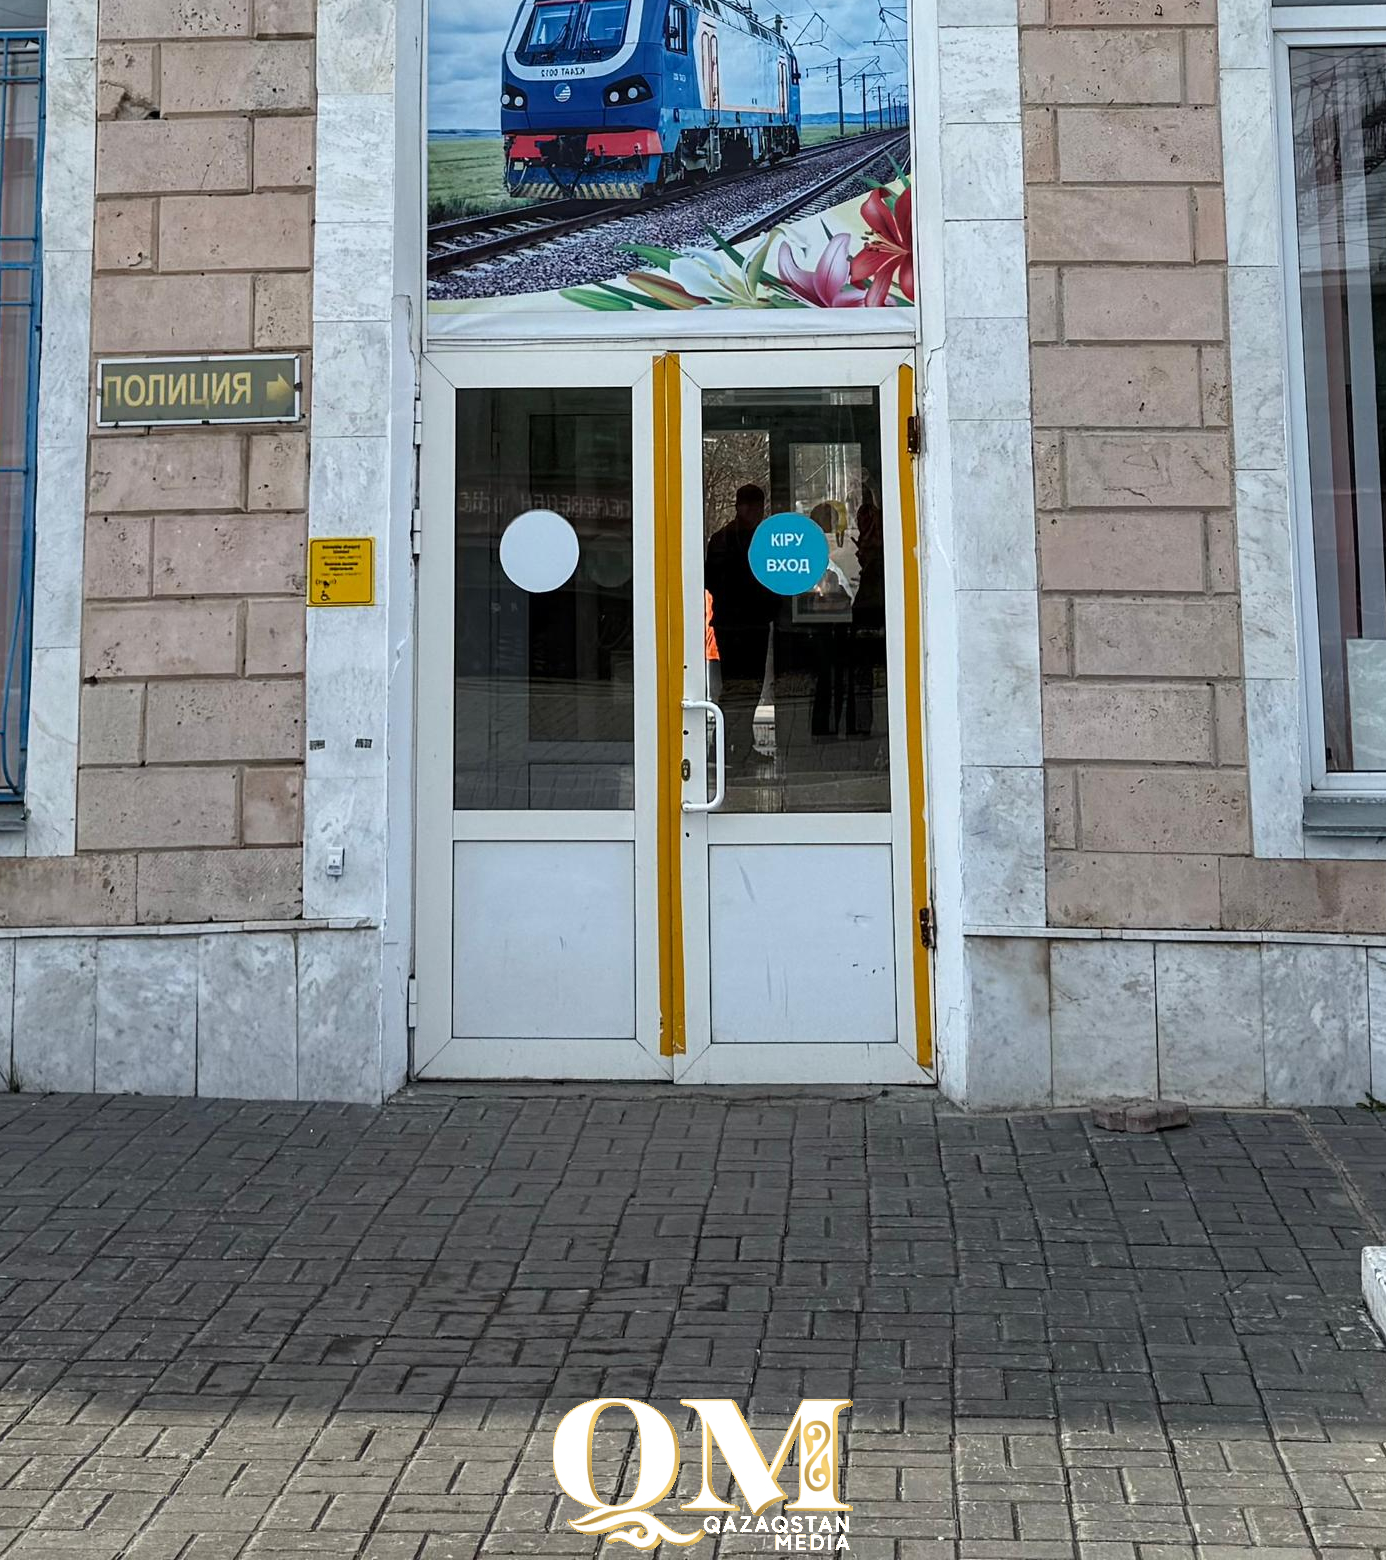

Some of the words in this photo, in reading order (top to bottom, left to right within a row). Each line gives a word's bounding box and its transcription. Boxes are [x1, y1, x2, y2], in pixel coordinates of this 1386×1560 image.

[103, 372, 252, 410] ПОЛИЦИЯ
[771, 533, 804, 547] КІРУ
[766, 559, 810, 574] ВХОД
